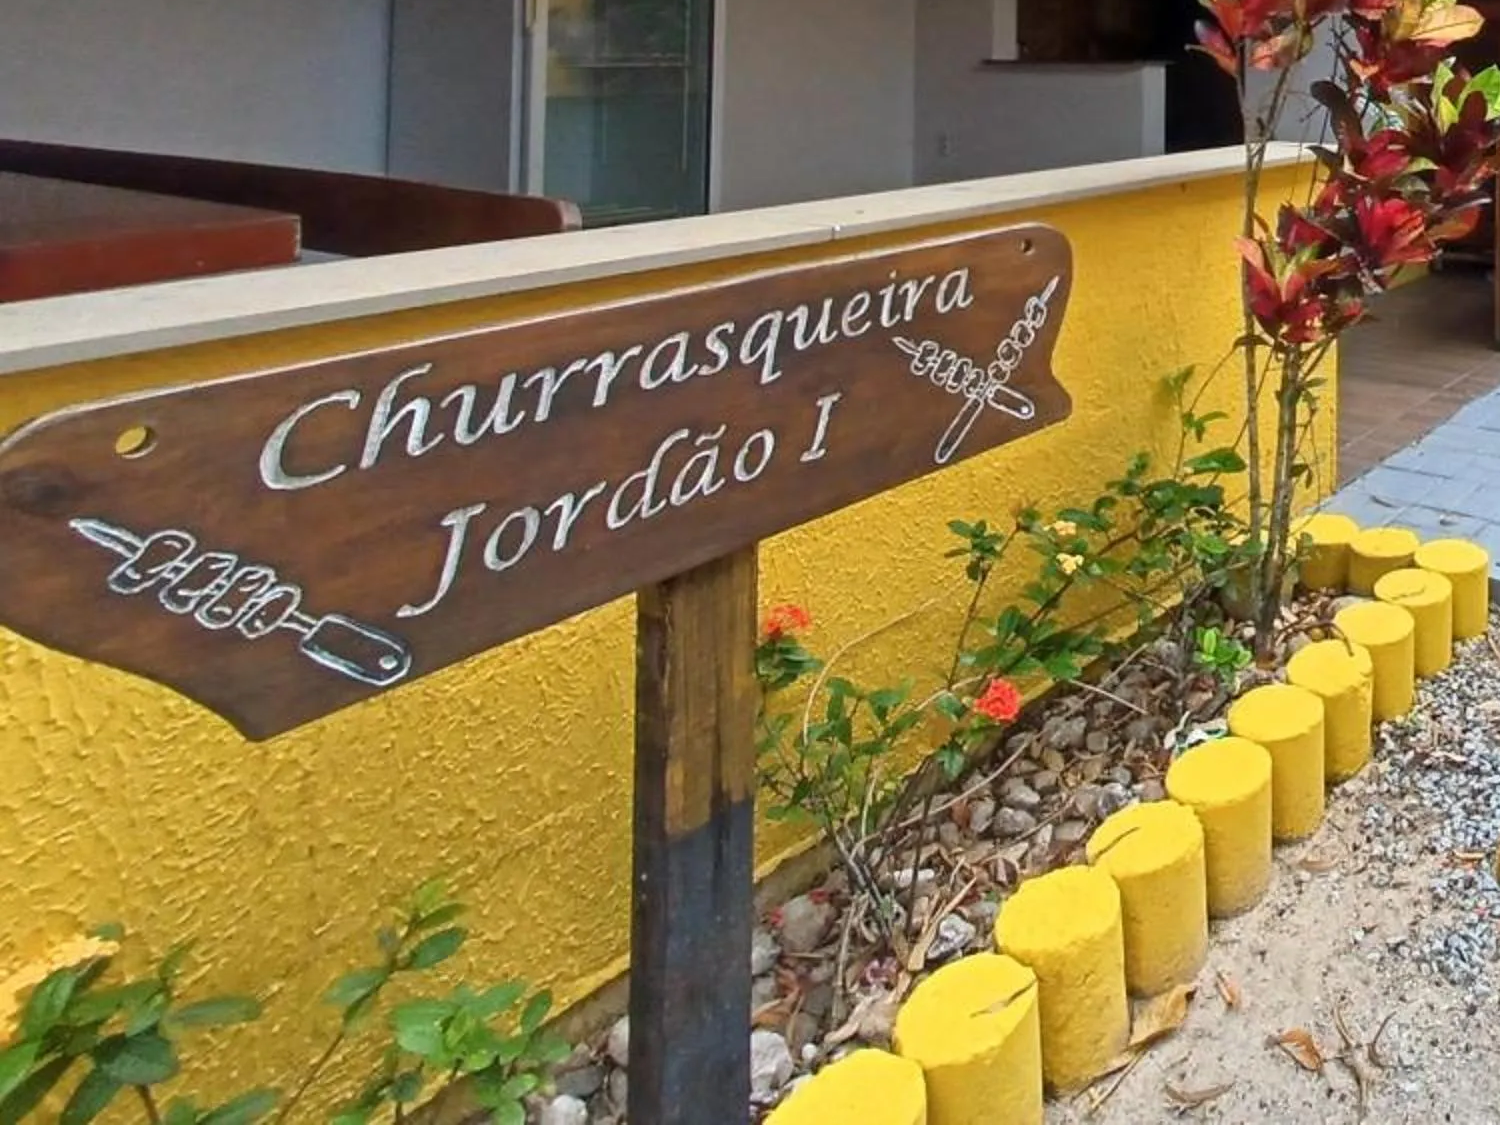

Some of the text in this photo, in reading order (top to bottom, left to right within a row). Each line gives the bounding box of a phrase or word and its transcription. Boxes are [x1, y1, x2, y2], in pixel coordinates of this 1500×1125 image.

[258, 267, 974, 491] Churrasqueira
[396, 392, 842, 619] Jordão I
